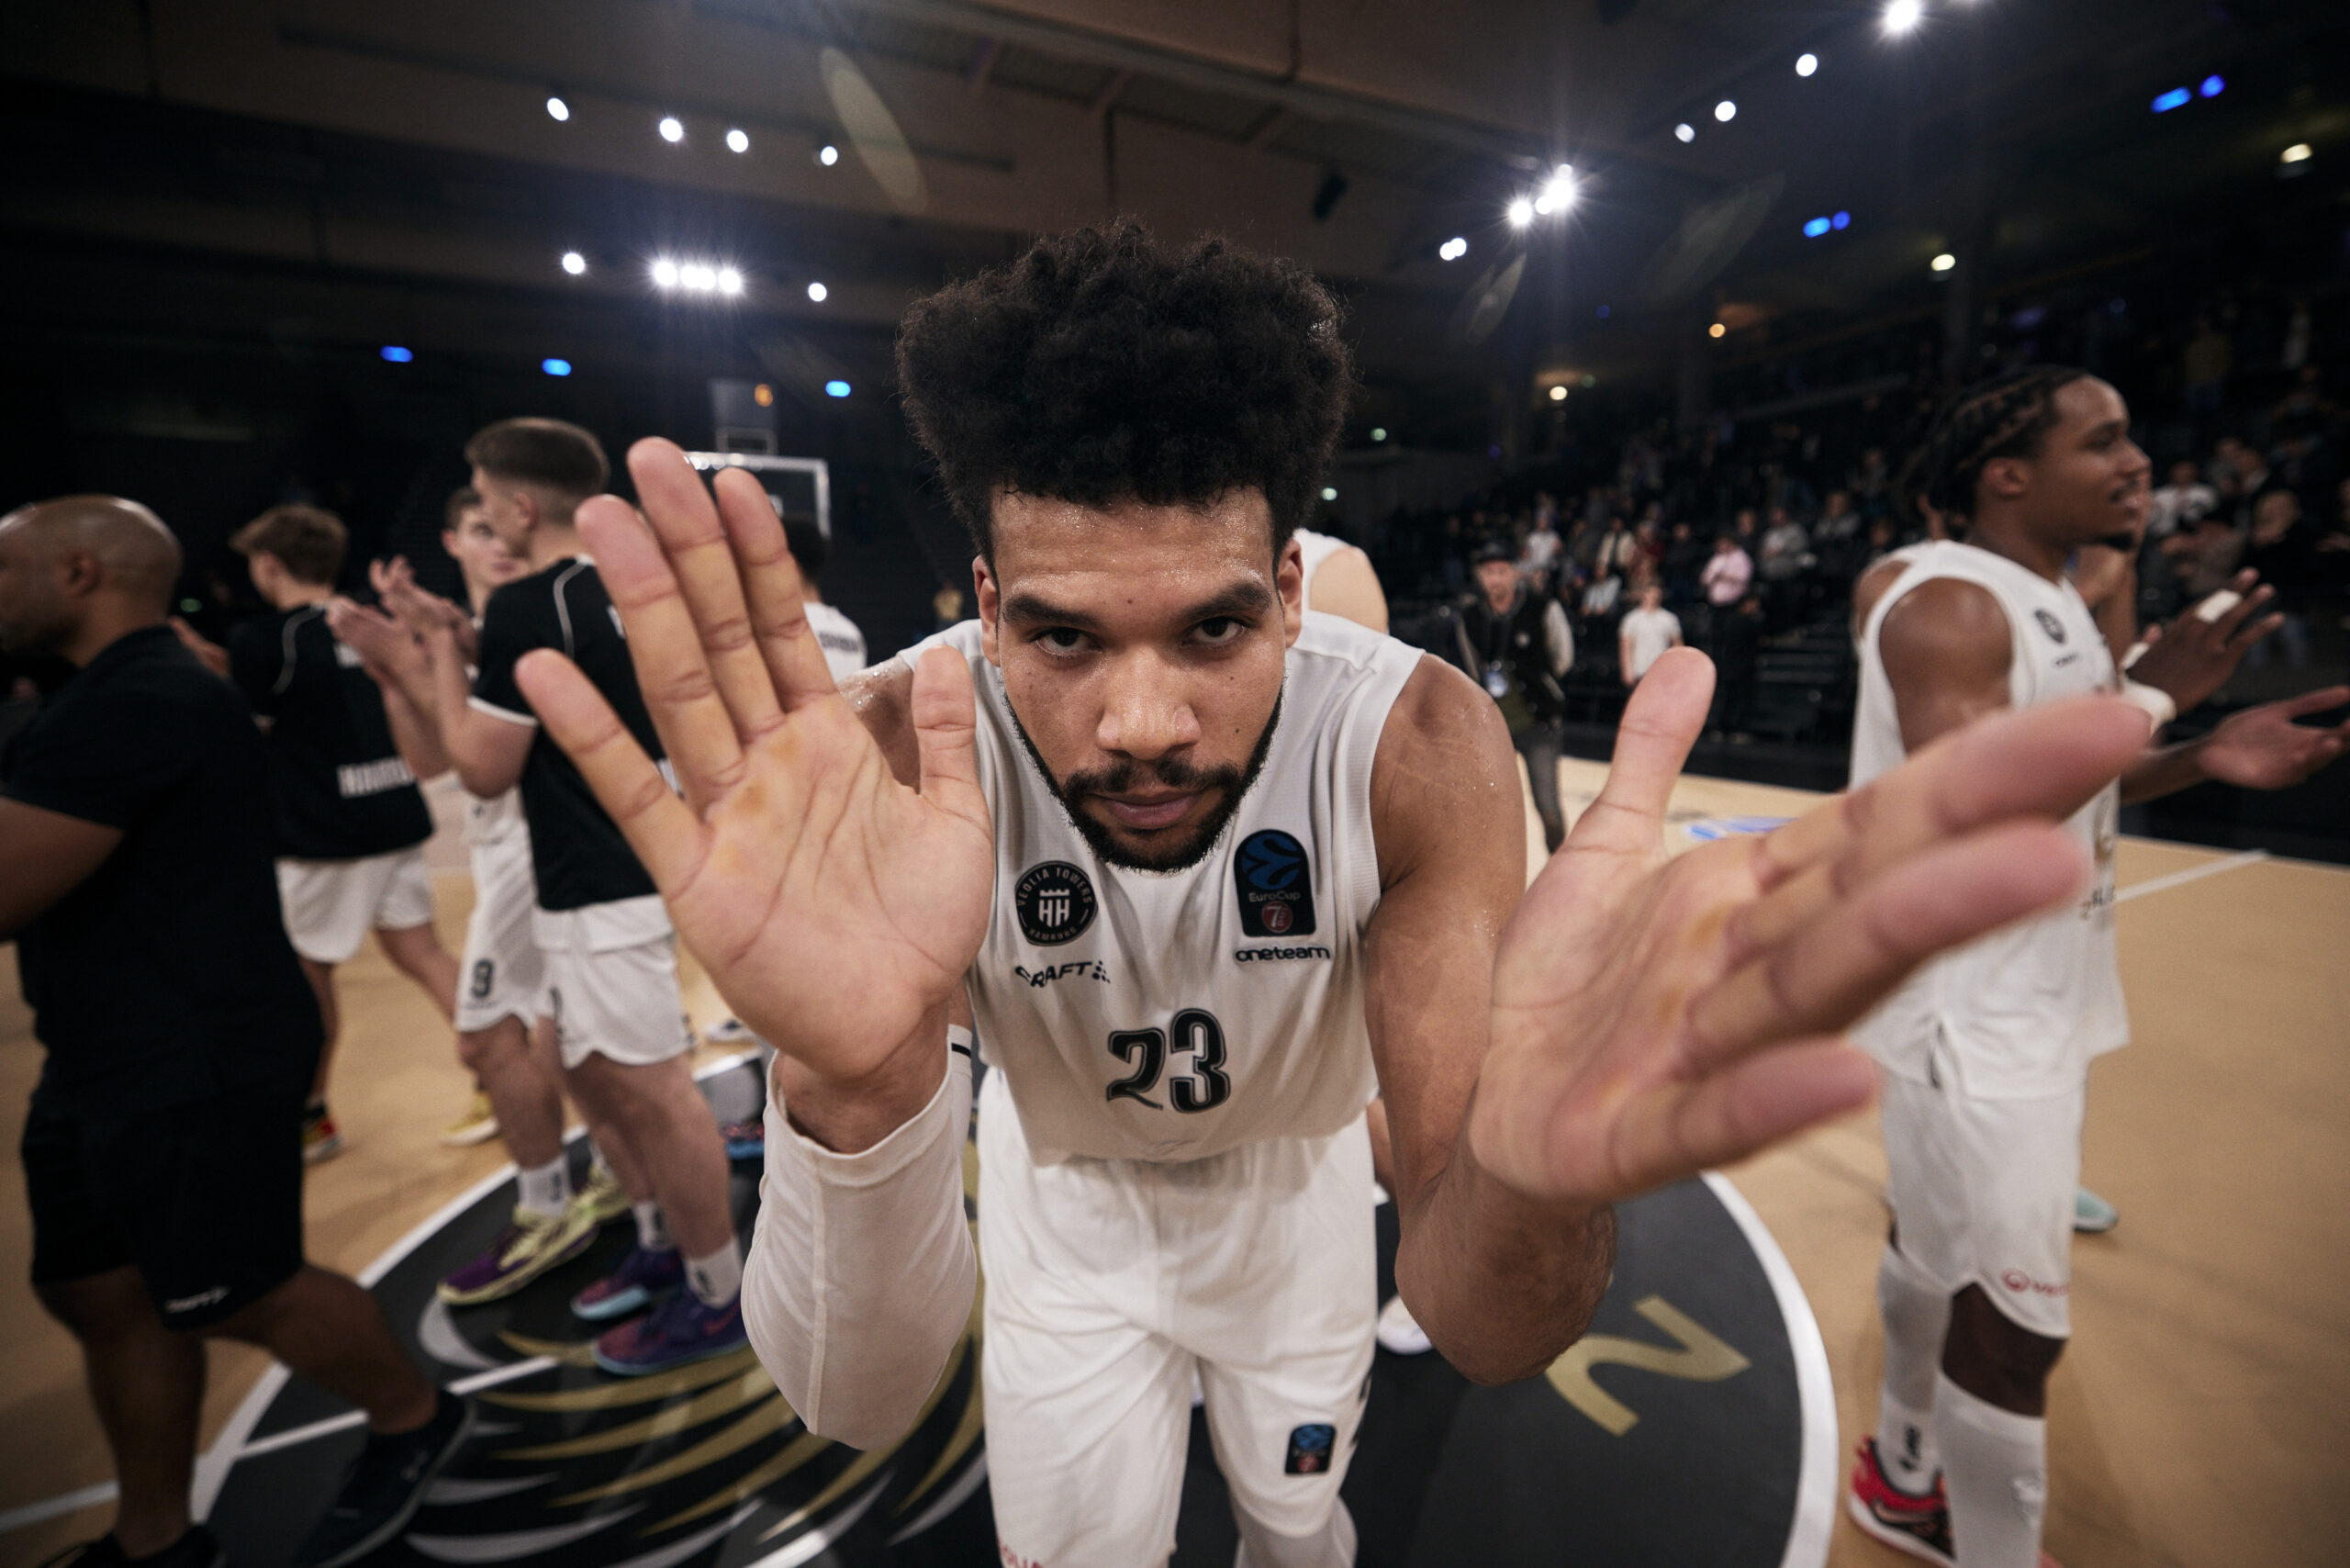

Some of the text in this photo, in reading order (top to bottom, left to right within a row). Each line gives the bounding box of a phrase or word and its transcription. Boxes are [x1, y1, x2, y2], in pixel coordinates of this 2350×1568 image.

[1017, 868, 1092, 906] VEOLIA TOWERS
[1248, 890, 1301, 902] EuroCup
[1267, 905, 1282, 928] 7
[1236, 946, 1331, 962] oneteam
[1106, 1008, 1231, 1114] 23
